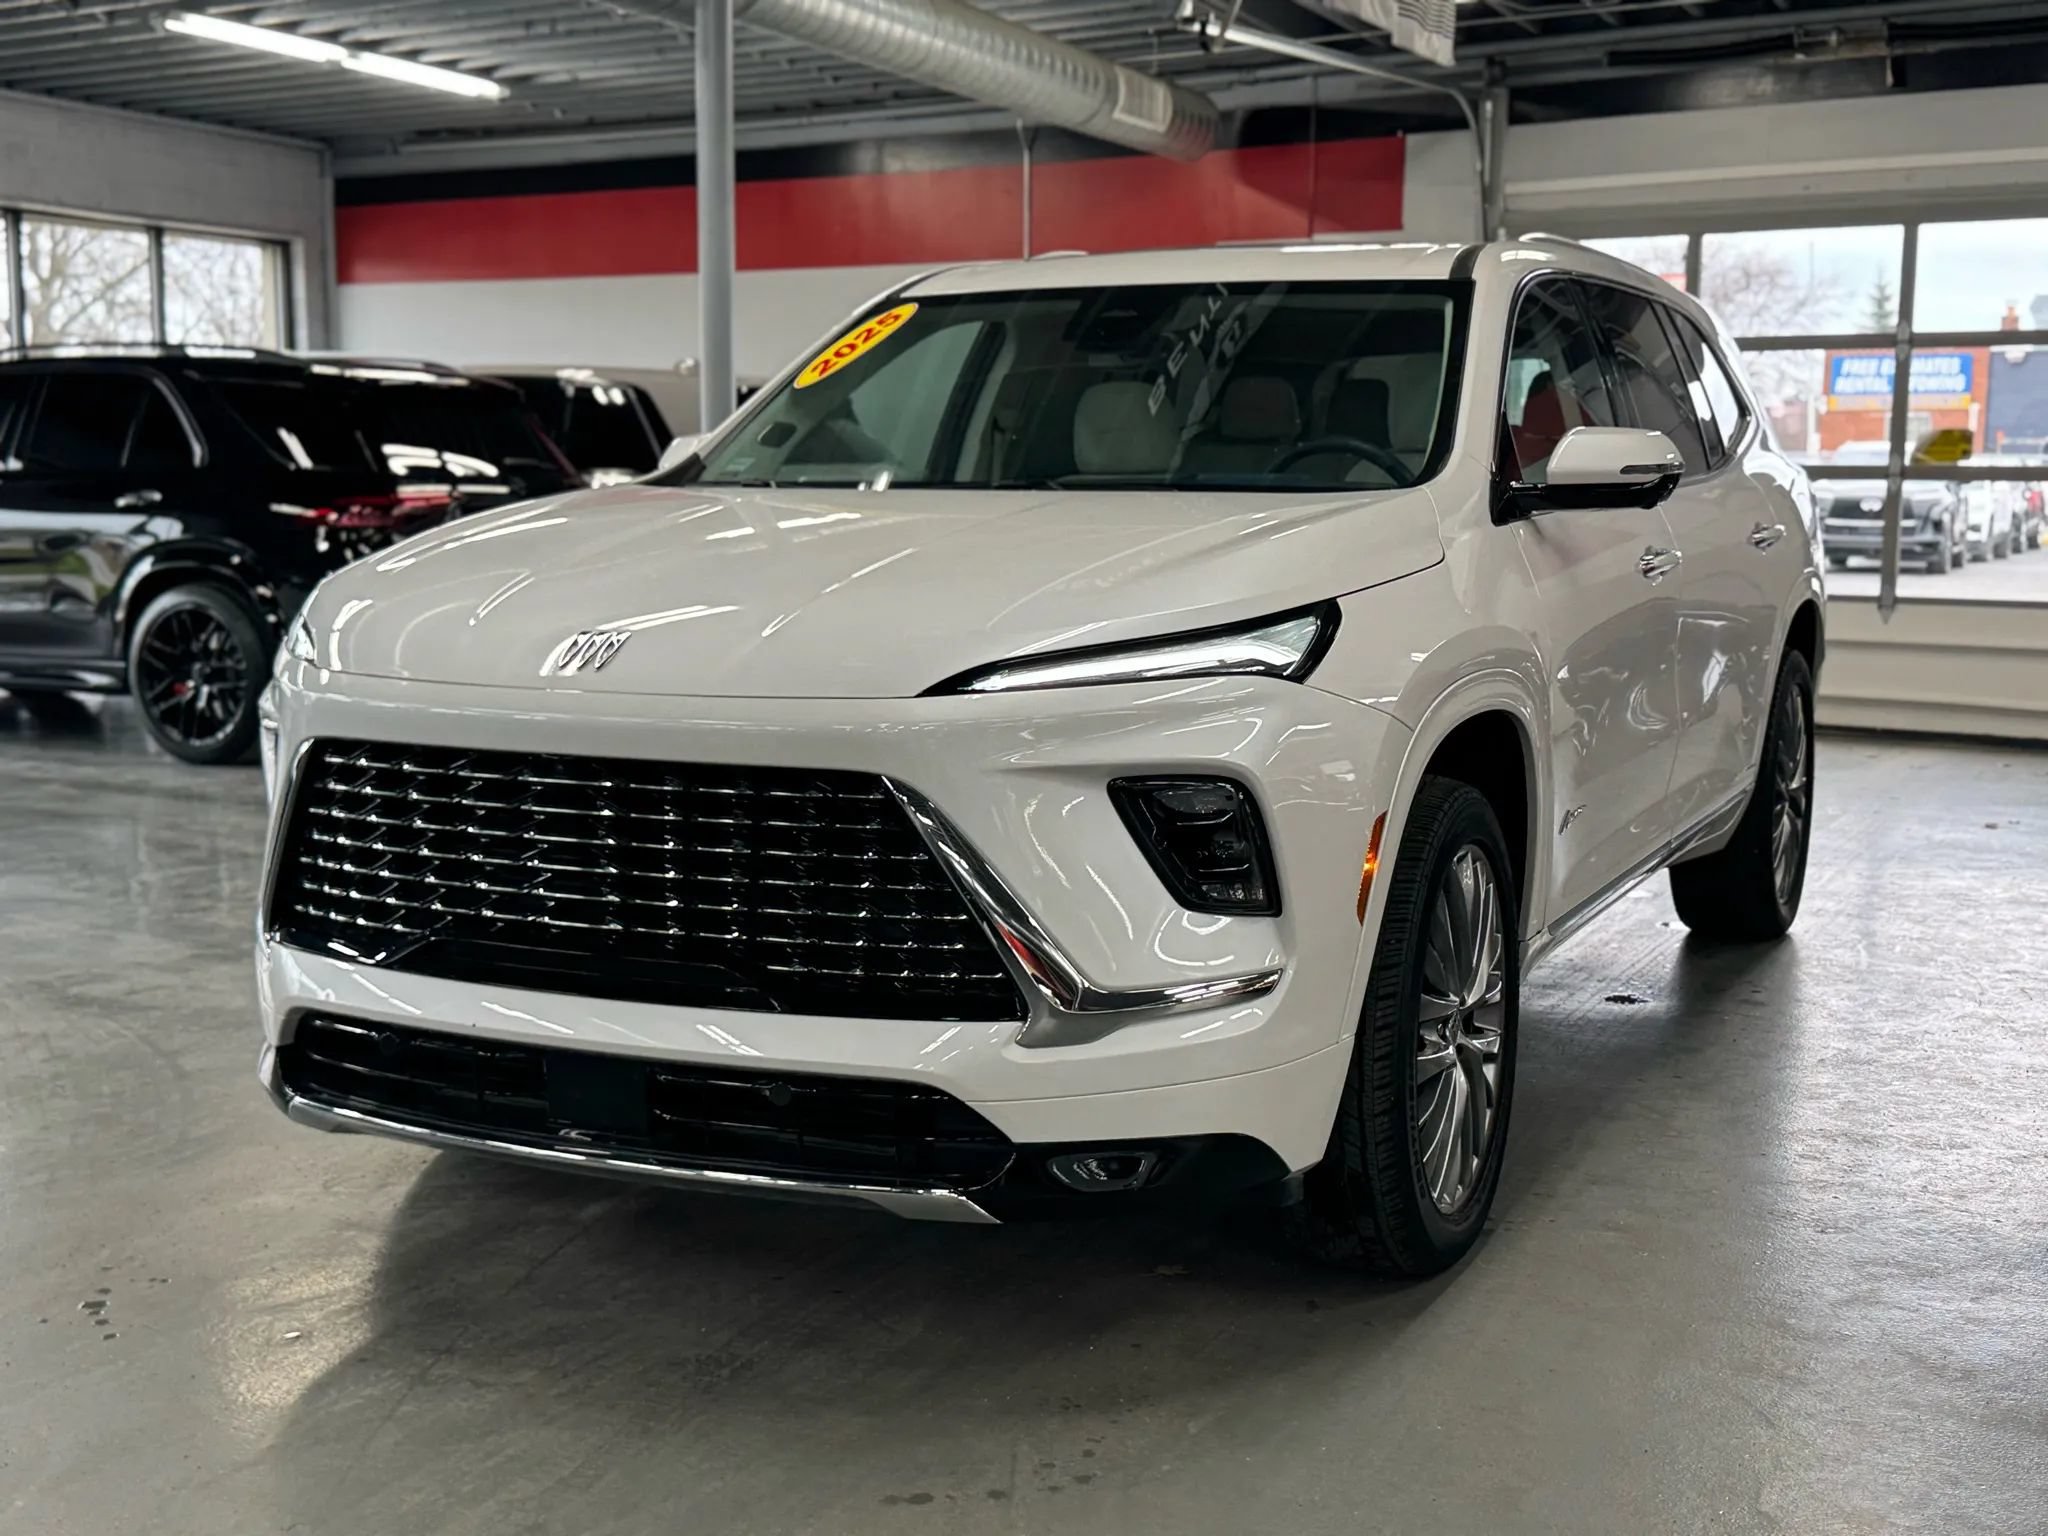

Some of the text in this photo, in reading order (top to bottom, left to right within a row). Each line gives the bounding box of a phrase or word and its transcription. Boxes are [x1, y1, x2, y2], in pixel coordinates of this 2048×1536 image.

[810, 312, 902, 377] 2025
[1841, 356, 1962, 376] FREE EMATES
